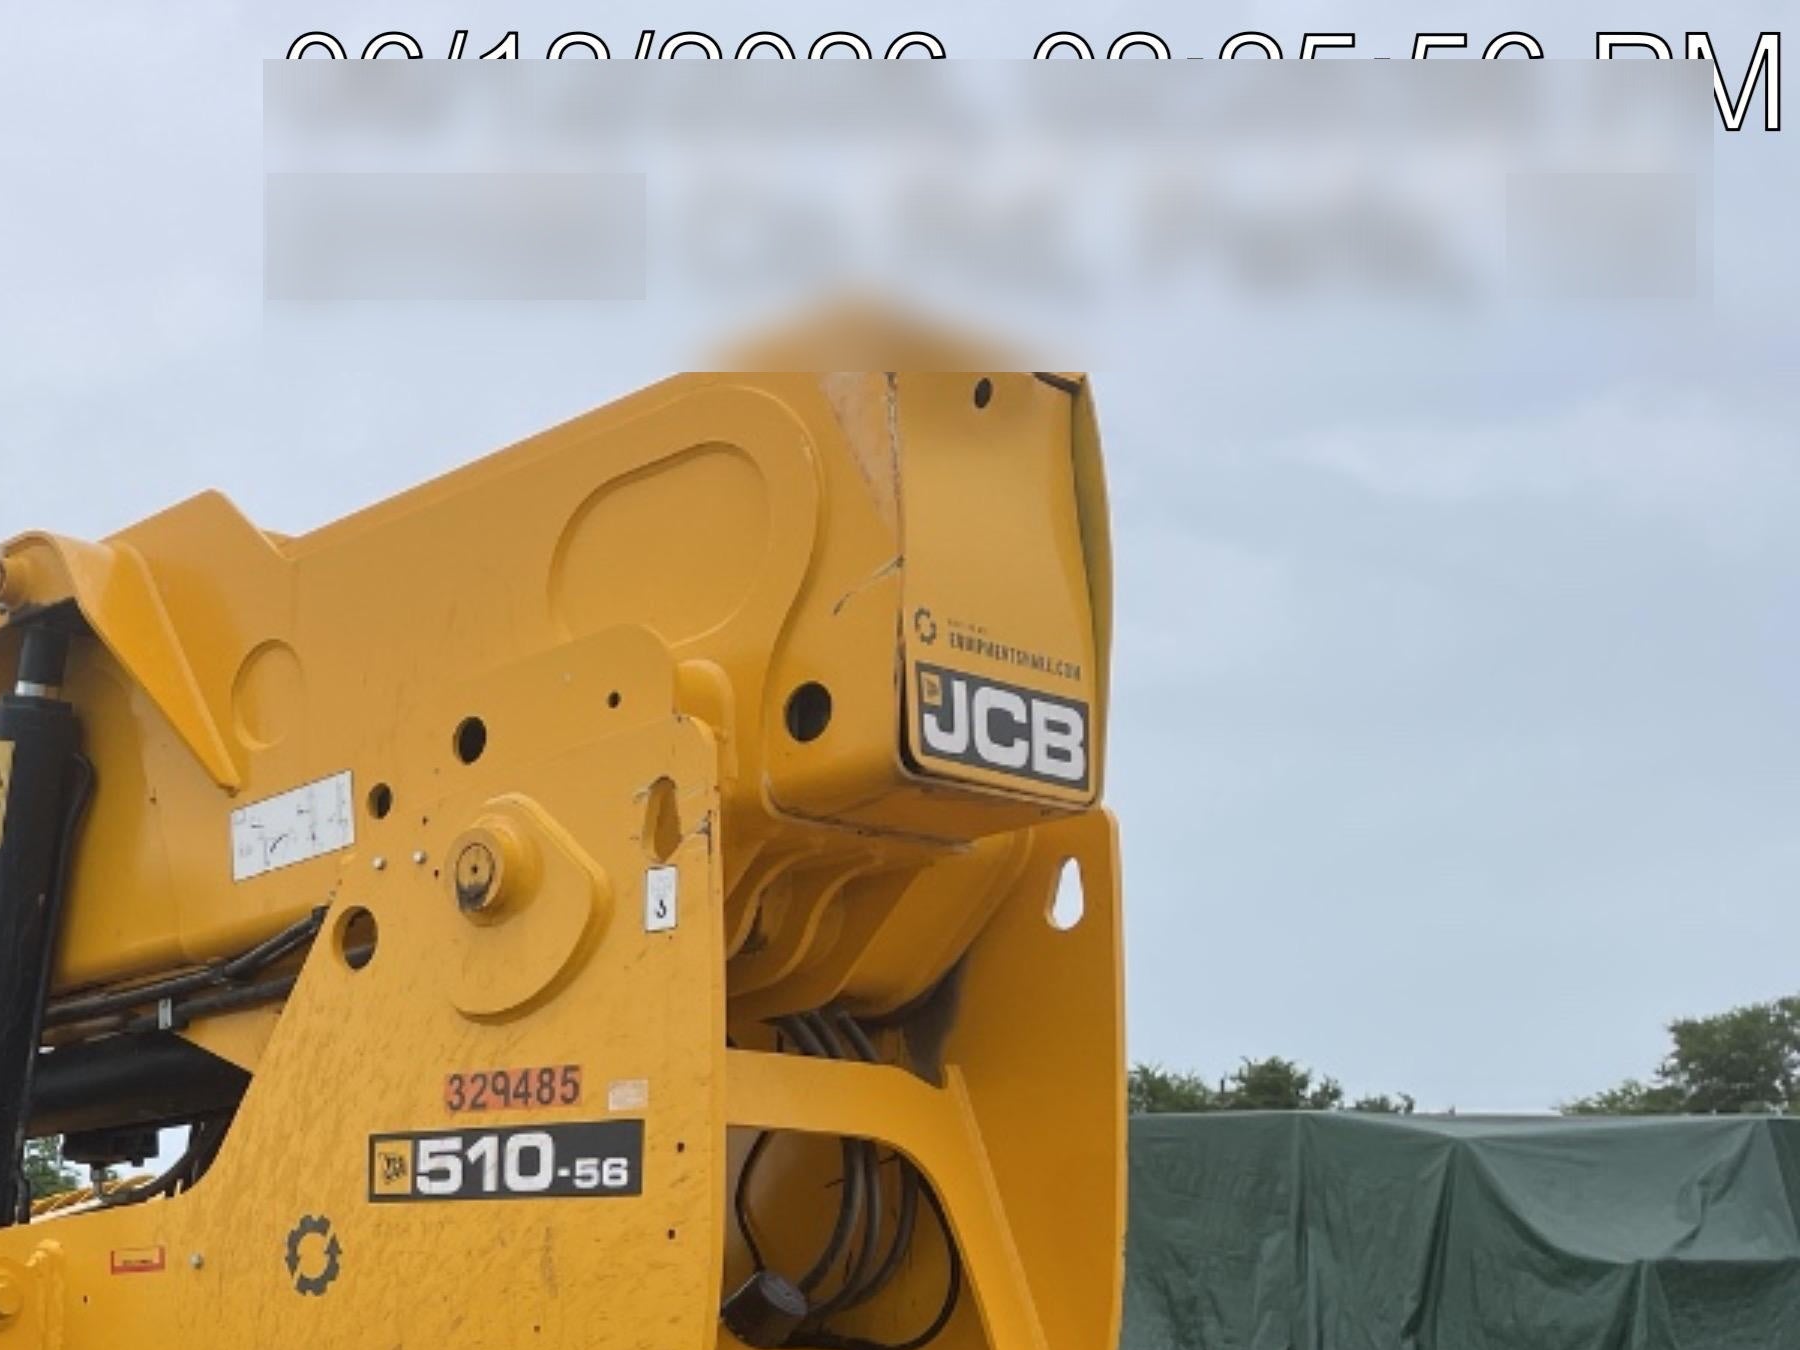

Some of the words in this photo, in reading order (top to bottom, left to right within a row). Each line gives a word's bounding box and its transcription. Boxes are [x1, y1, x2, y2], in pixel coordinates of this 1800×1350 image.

[922, 679, 1085, 781] JCB
[447, 1064, 581, 1111] 329485
[415, 1131, 629, 1195] 510-56
